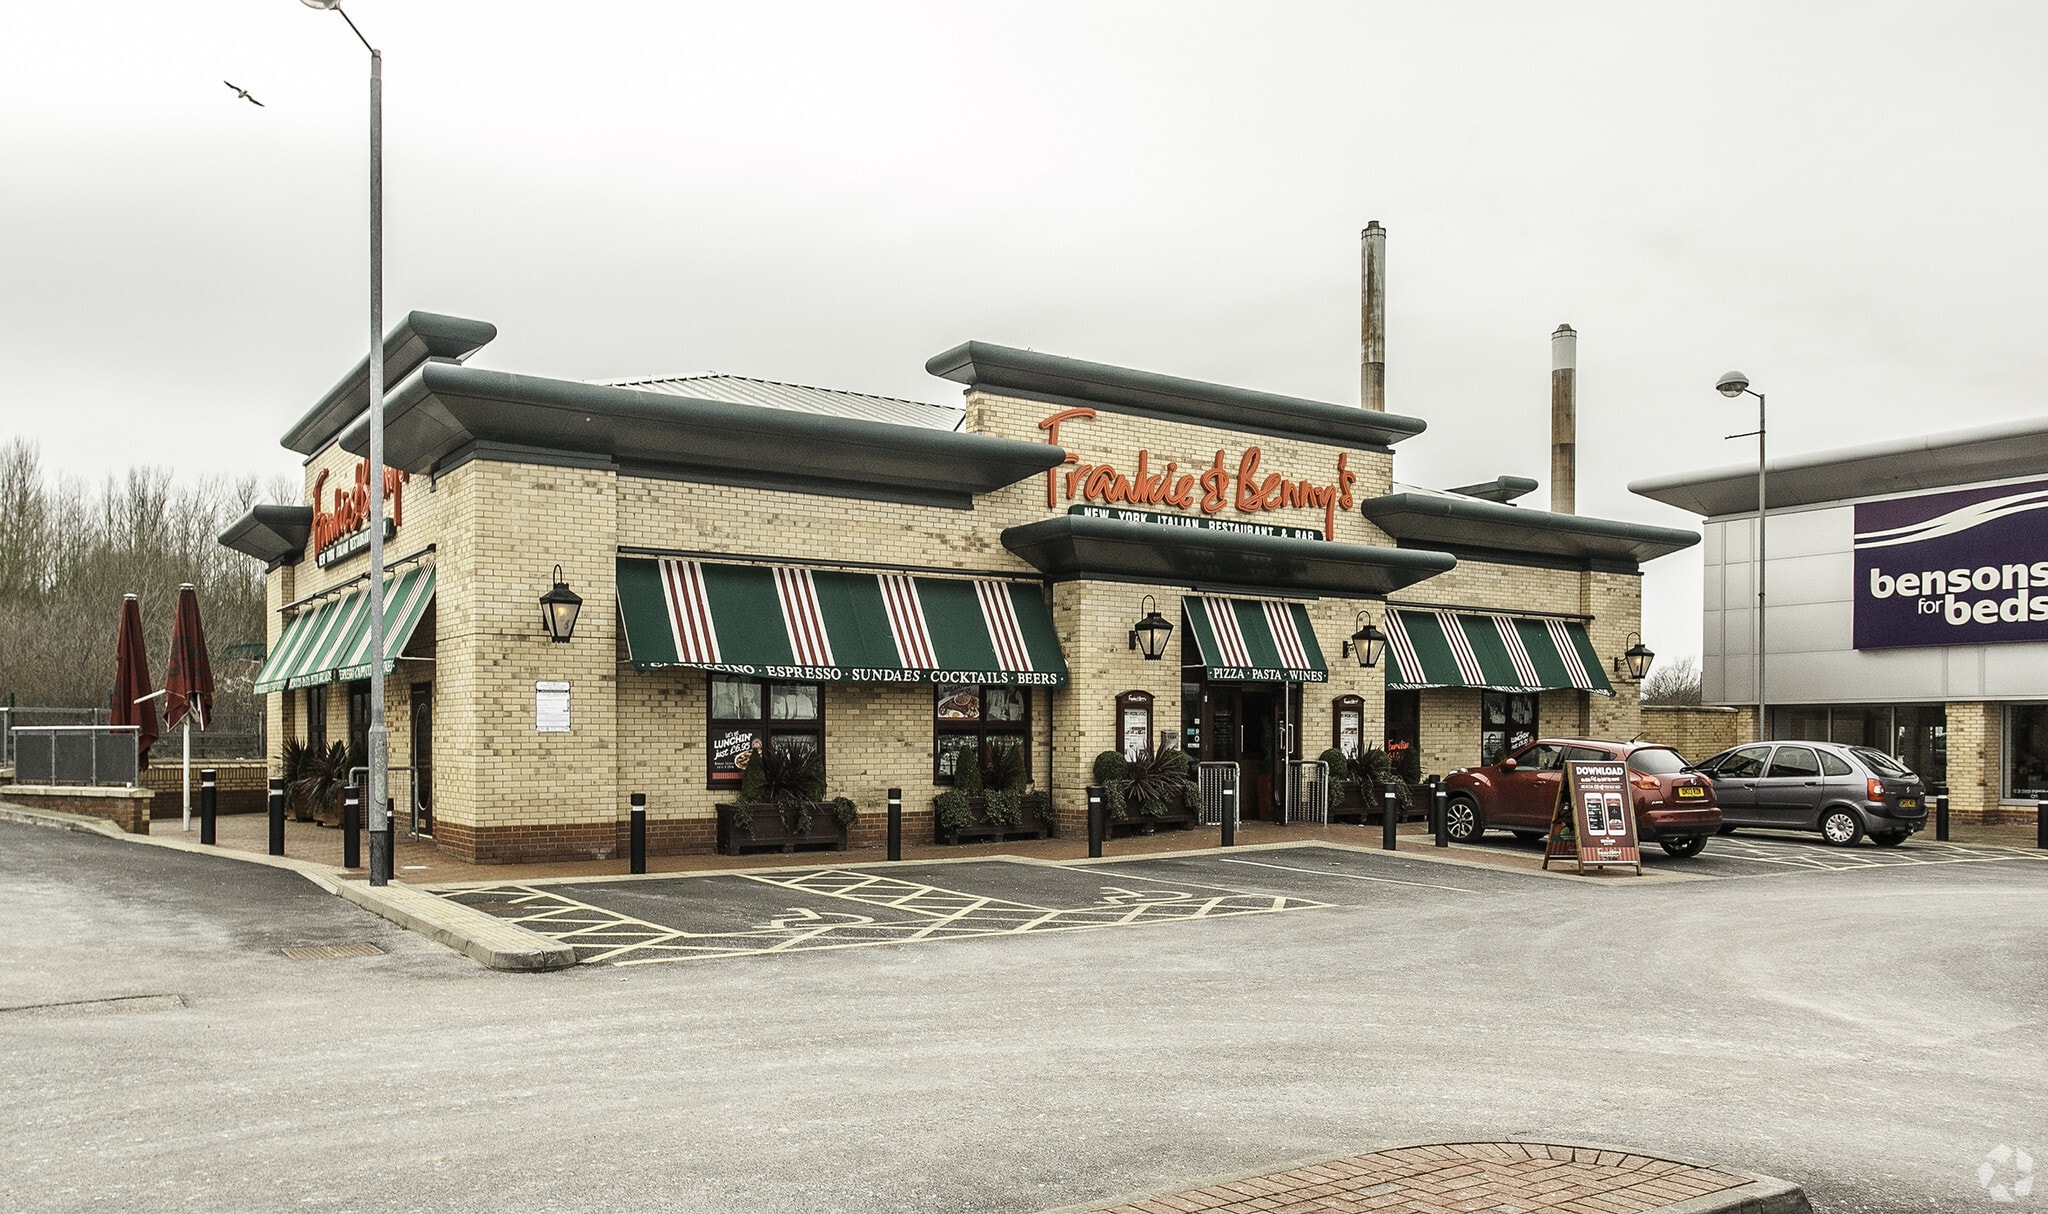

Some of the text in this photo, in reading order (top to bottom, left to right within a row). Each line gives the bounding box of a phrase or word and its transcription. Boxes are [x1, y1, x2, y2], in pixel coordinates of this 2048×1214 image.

[1038, 407, 1357, 541] Frankie & Benny's
[1084, 507, 1110, 519] NEW
[1118, 511, 1148, 523] YORK
[1157, 515, 1199, 529] ITALIAN
[1208, 520, 1274, 537] RESTAURANT
[1870, 561, 2048, 599] bensons
[1918, 588, 2048, 626] for beds
[765, 665, 842, 681] ESPRESSO
[851, 668, 921, 682] SUNDAES
[930, 670, 1009, 684] COCKTAILS
[1017, 673, 1058, 685] BEERS
[1213, 667, 1323, 681] PIZZA PASTA WINES
[1575, 766, 1624, 776] DOWNLOAD
